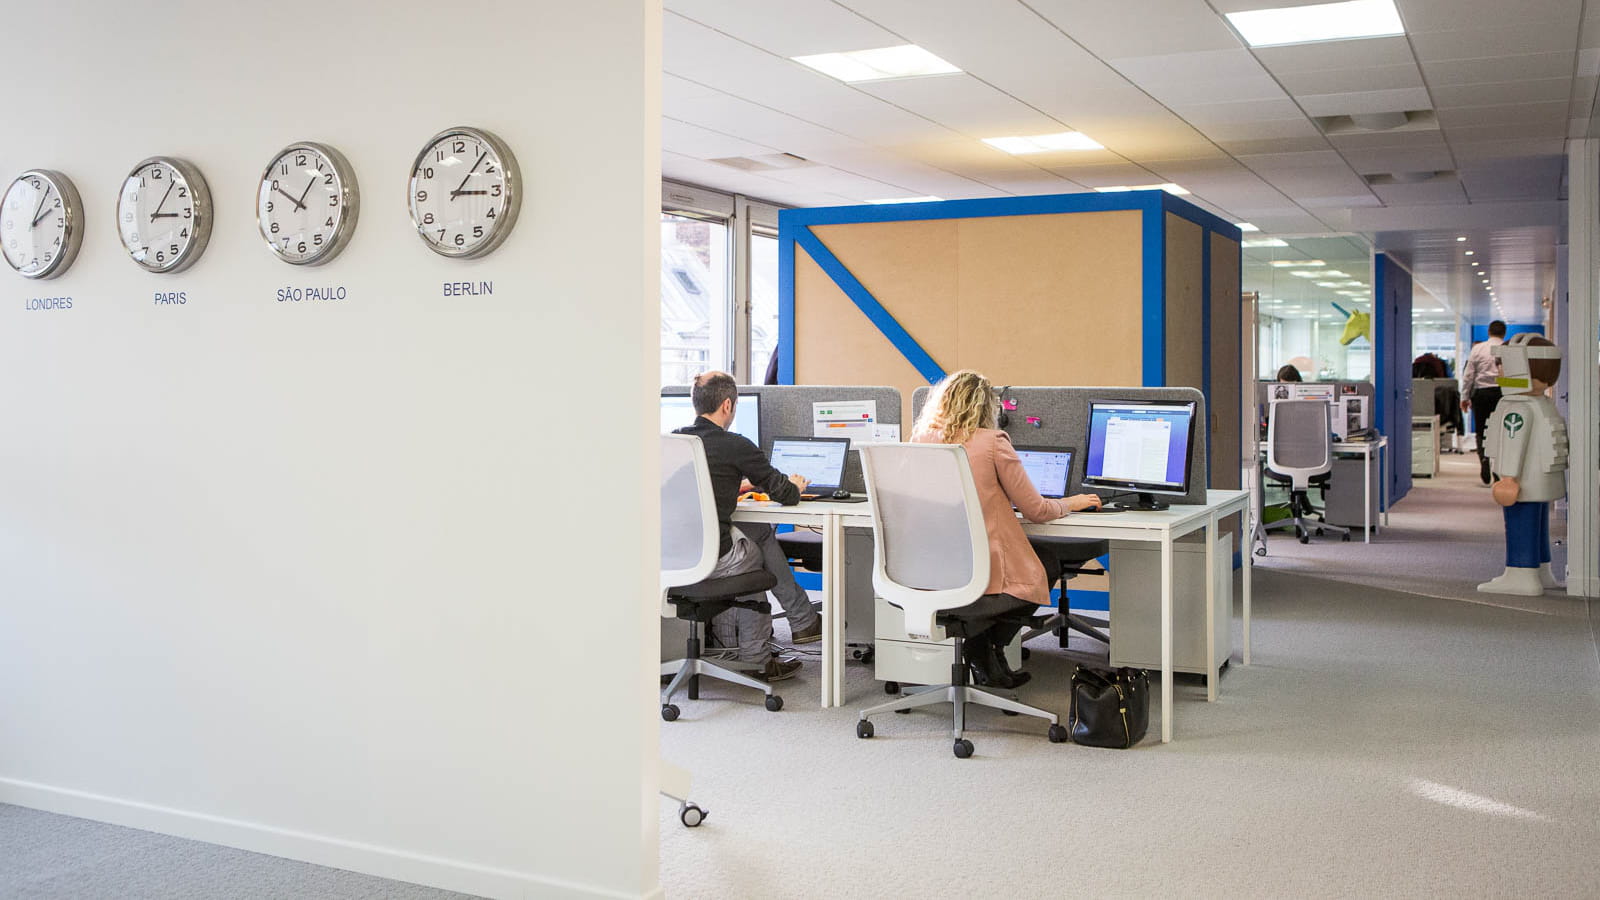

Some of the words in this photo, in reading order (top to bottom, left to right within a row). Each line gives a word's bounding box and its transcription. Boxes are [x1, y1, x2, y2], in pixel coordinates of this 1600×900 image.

[453, 142, 465, 153] 12
[296, 155, 307, 166] 12
[437, 151, 444, 162] 11
[152, 169, 162, 179] 12
[282, 164, 288, 175] 11
[424, 168, 434, 179] 10
[325, 174, 333, 185] 2
[179, 188, 187, 198] 2
[417, 191, 428, 202] 9
[491, 185, 502, 197] 3
[54, 198, 61, 208] 2
[267, 202, 274, 212] 9
[330, 196, 338, 207] 3
[184, 208, 192, 218] 3
[487, 208, 496, 219] 4
[58, 218, 64, 228] 3
[326, 217, 334, 227] 4
[424, 213, 434, 225] 8
[180, 228, 188, 238] 4
[271, 223, 279, 233] 8
[473, 226, 483, 238] 5
[314, 234, 323, 245] 5
[437, 229, 446, 241] 7
[455, 234, 465, 246] 6
[54, 237, 60, 246] 4
[282, 238, 290, 249] 7
[170, 245, 179, 255] 5
[298, 242, 307, 253] 6
[44, 252, 52, 262] 5
[156, 252, 165, 262] 6
[277, 287, 302, 302] SÃO
[305, 287, 346, 301] PAULO
[443, 281, 493, 297] BERLIN
[26, 297, 73, 310] LONDRES
[154, 292, 187, 305] PARIS
